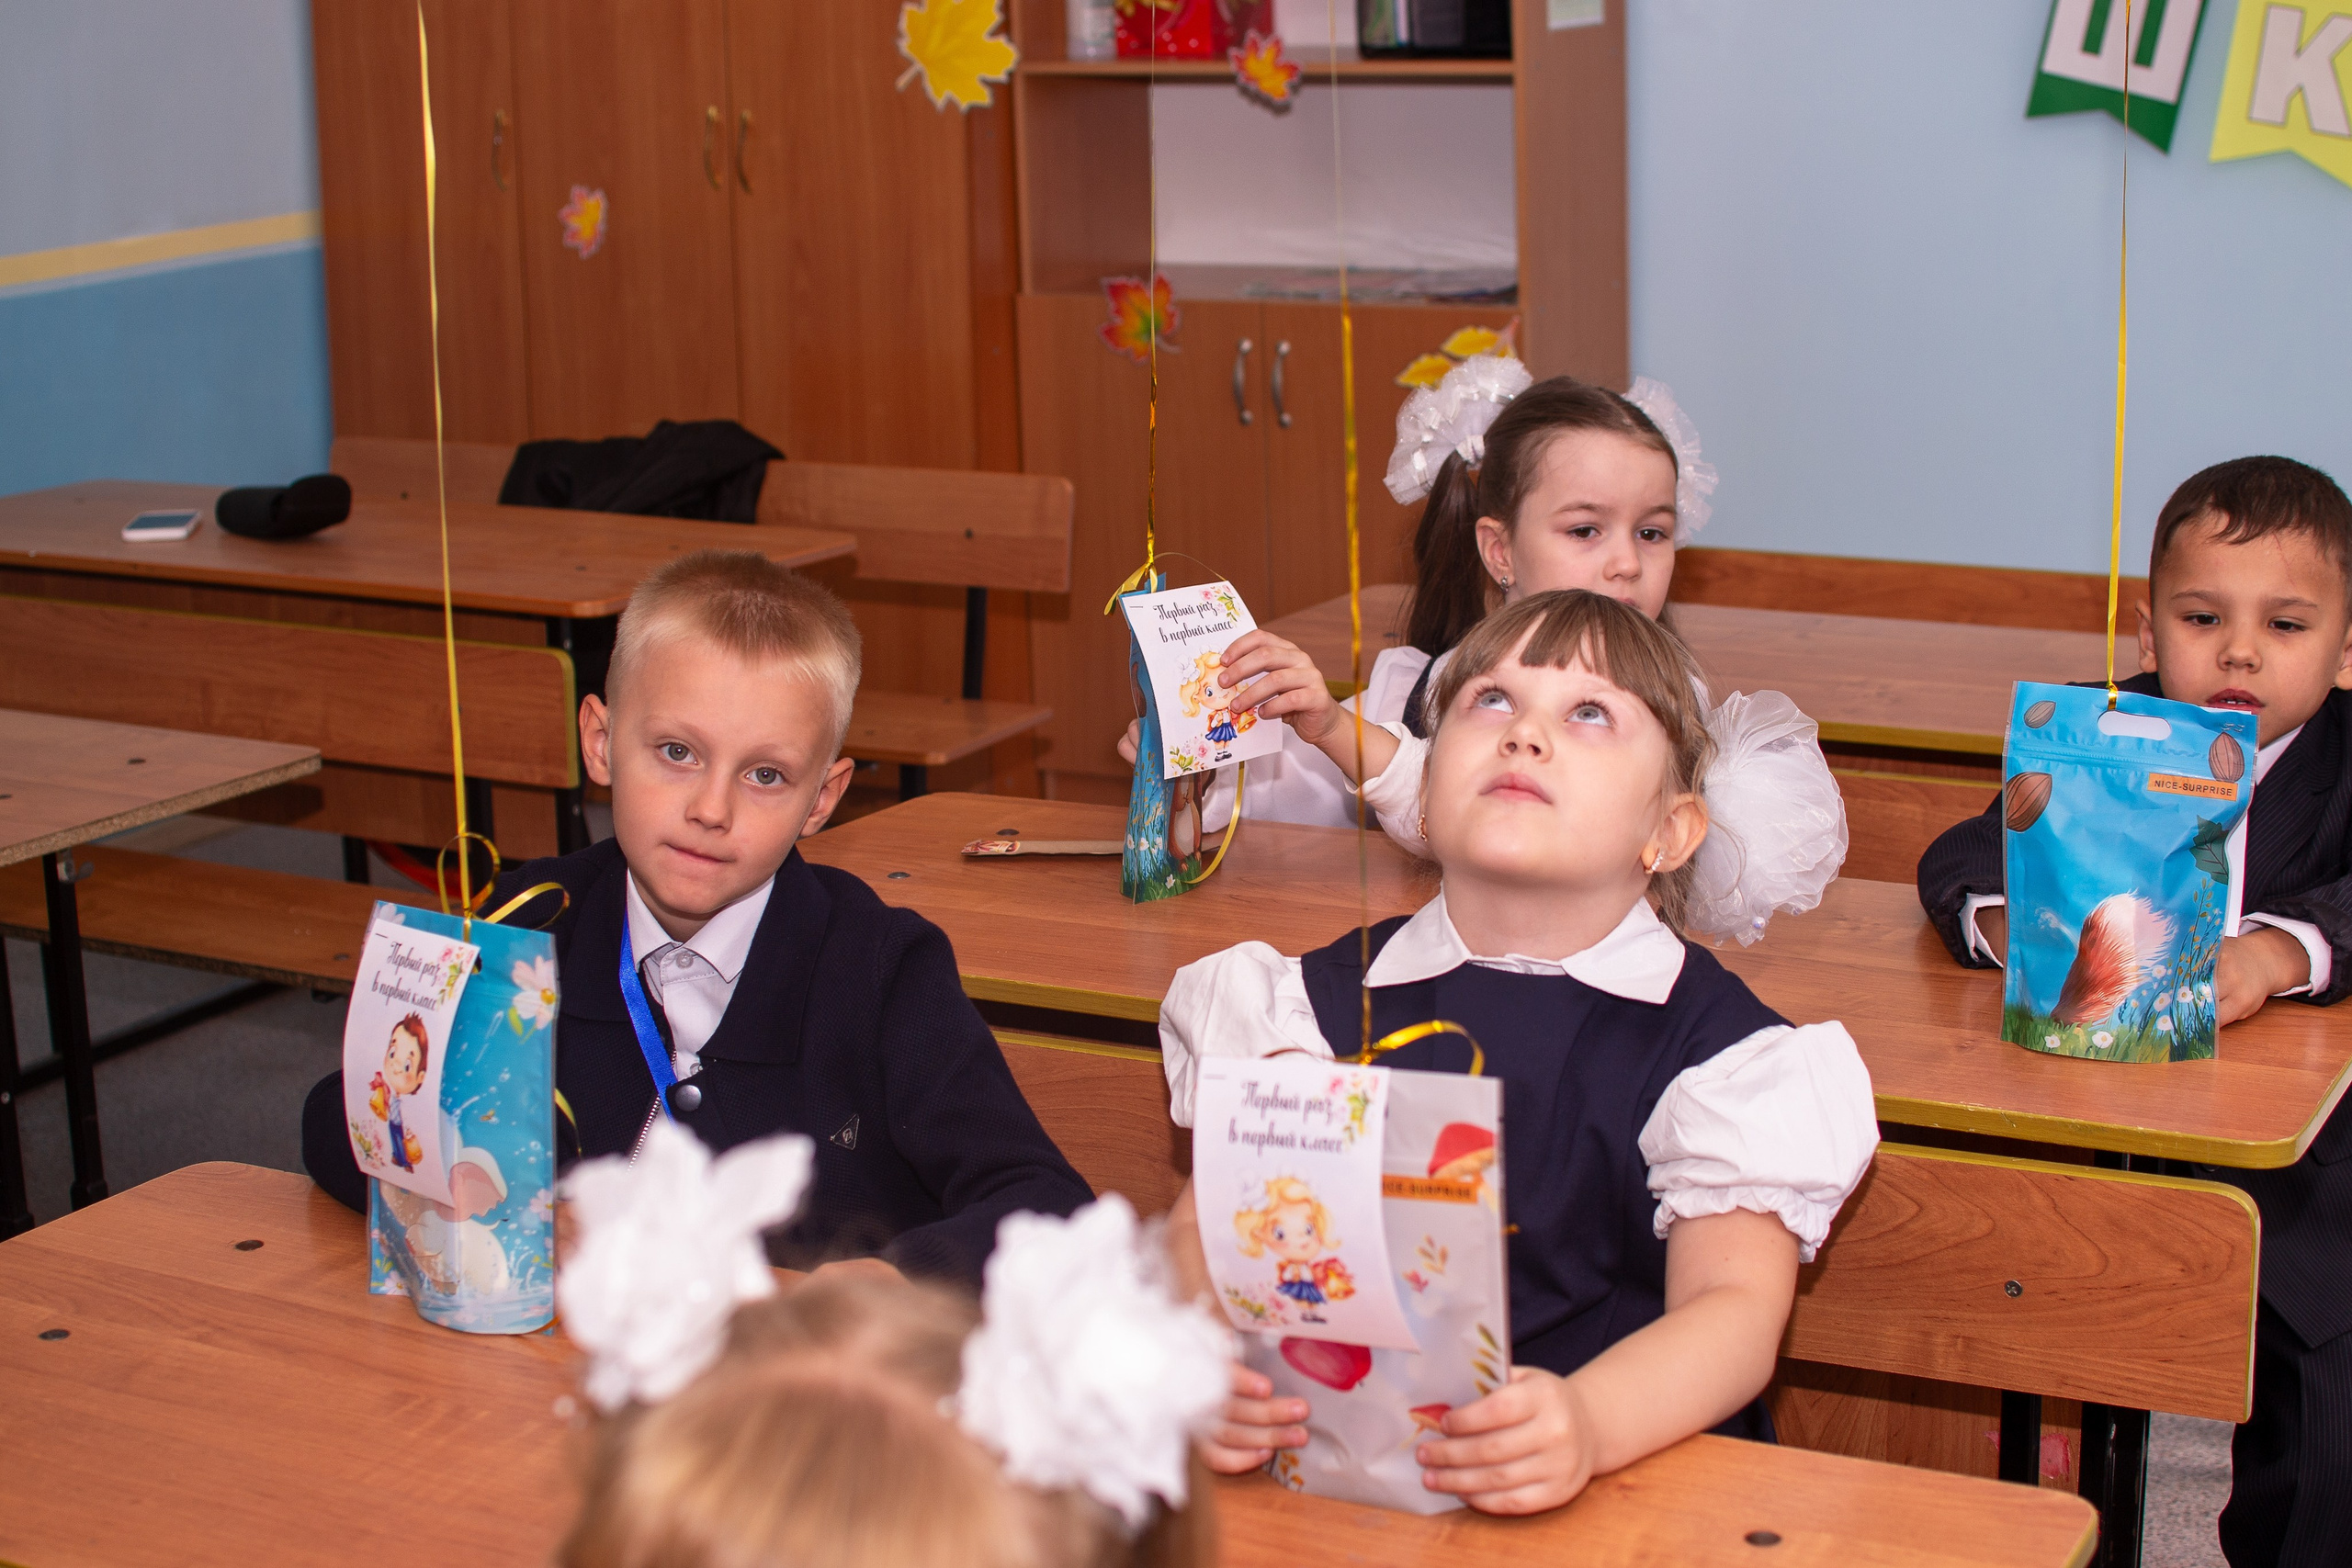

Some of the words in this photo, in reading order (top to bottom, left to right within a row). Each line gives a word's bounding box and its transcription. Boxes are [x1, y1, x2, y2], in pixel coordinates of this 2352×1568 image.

[1153, 602, 1196, 625] Первый
[1196, 601, 1218, 619] раз
[1159, 626, 1169, 643] в
[1170, 622, 1205, 646] первый
[1206, 620, 1233, 633] класс
[2154, 780, 2233, 796] NICE-SURPRISE
[387, 942, 423, 976] Первый
[418, 963, 441, 987] раз
[371, 970, 381, 992] в
[379, 976, 412, 1006] первый
[411, 993, 437, 1011] класс
[1240, 1080, 1301, 1120] Первый
[1228, 1116, 1238, 1144] в
[1241, 1121, 1296, 1158] первый
